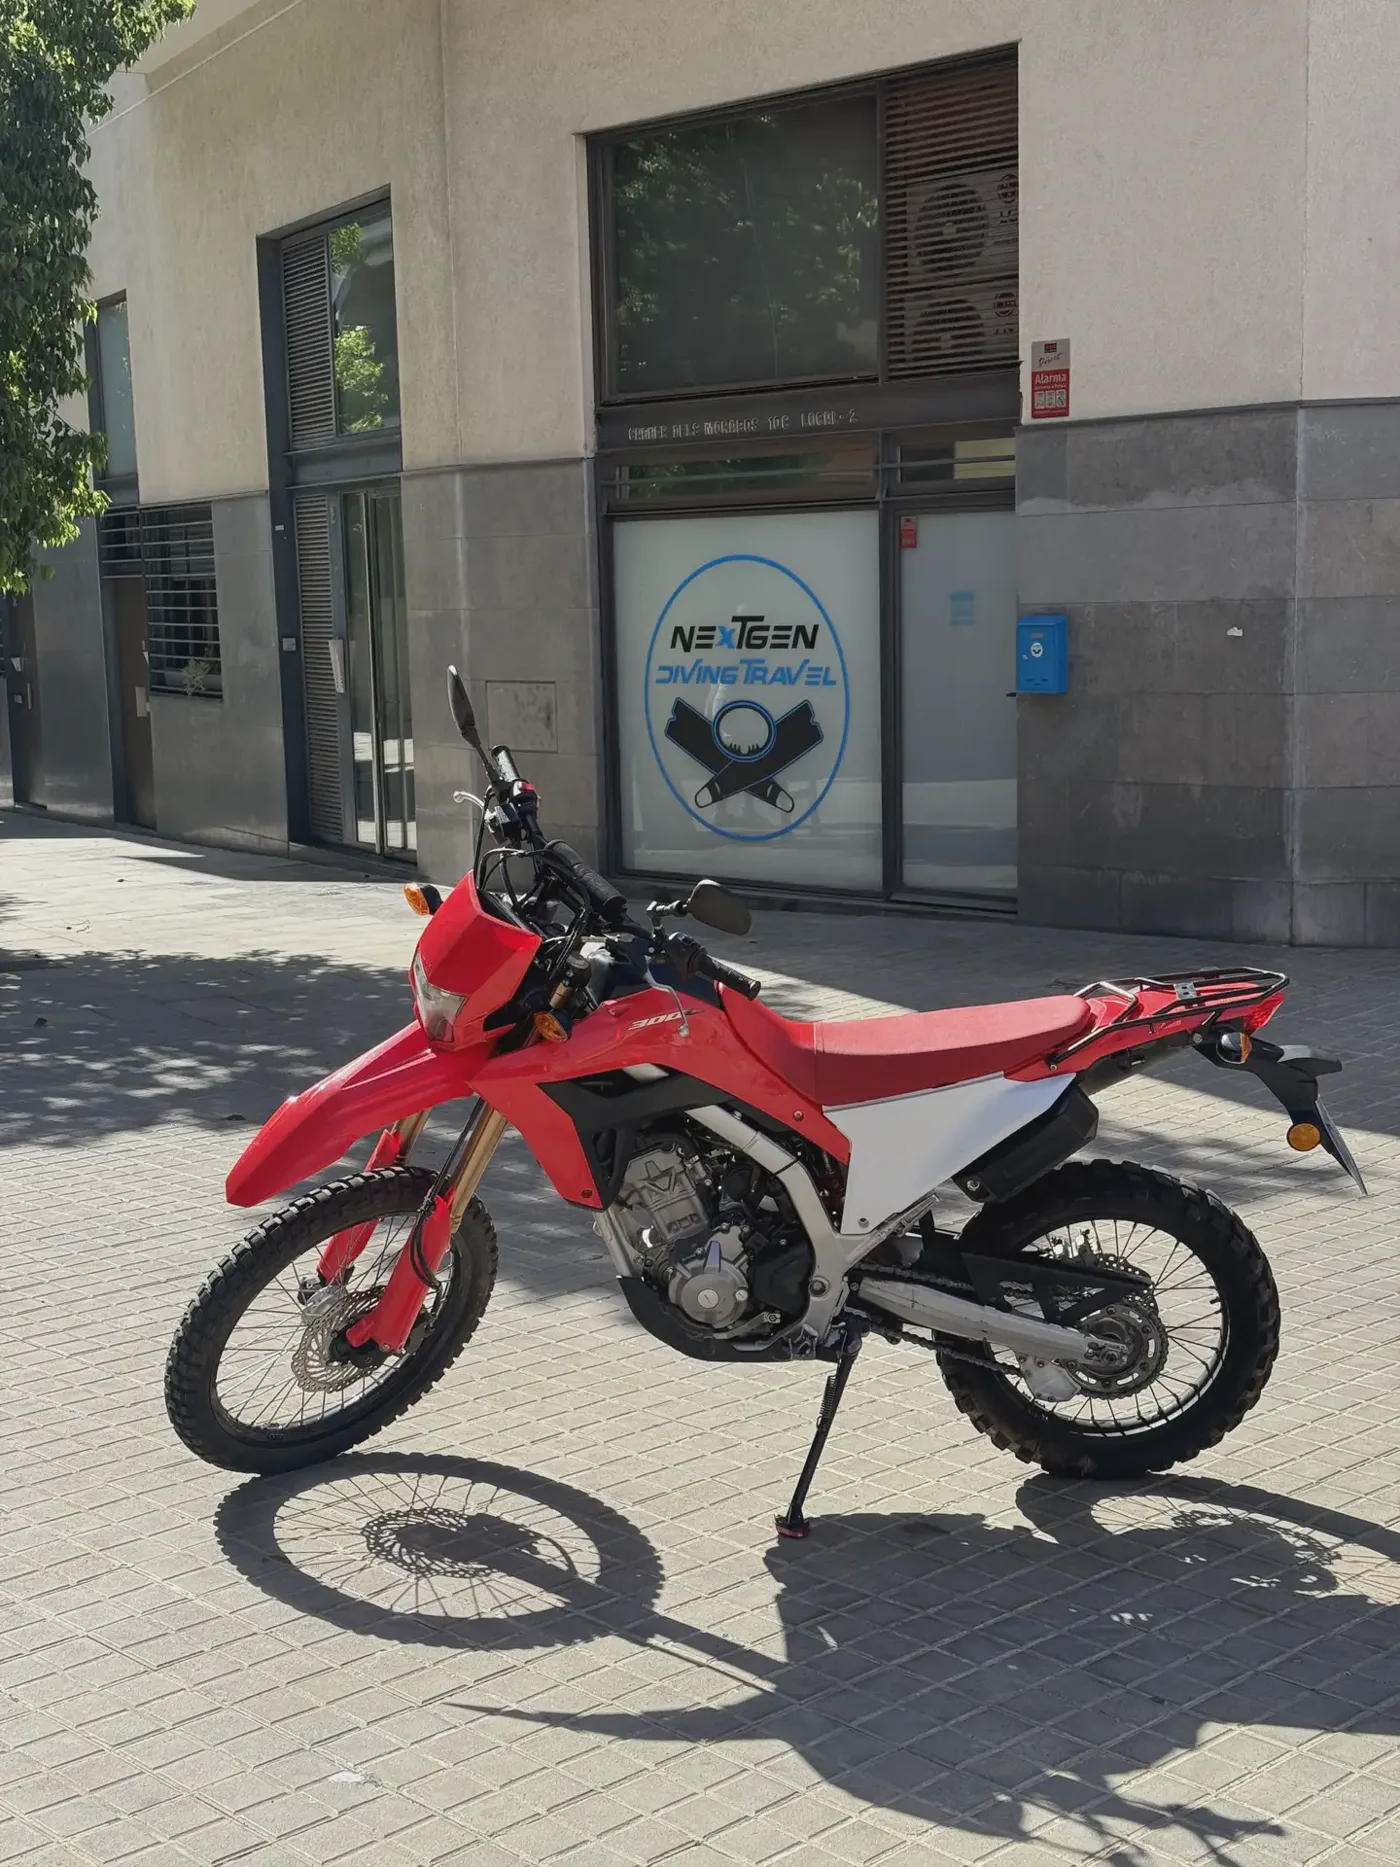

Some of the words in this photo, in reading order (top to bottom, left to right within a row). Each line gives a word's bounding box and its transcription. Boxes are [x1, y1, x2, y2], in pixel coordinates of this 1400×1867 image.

[1035, 373, 1067, 385] Alarma
[655, 658, 740, 685] DIVING
[740, 658, 837, 686] TRAVEL
